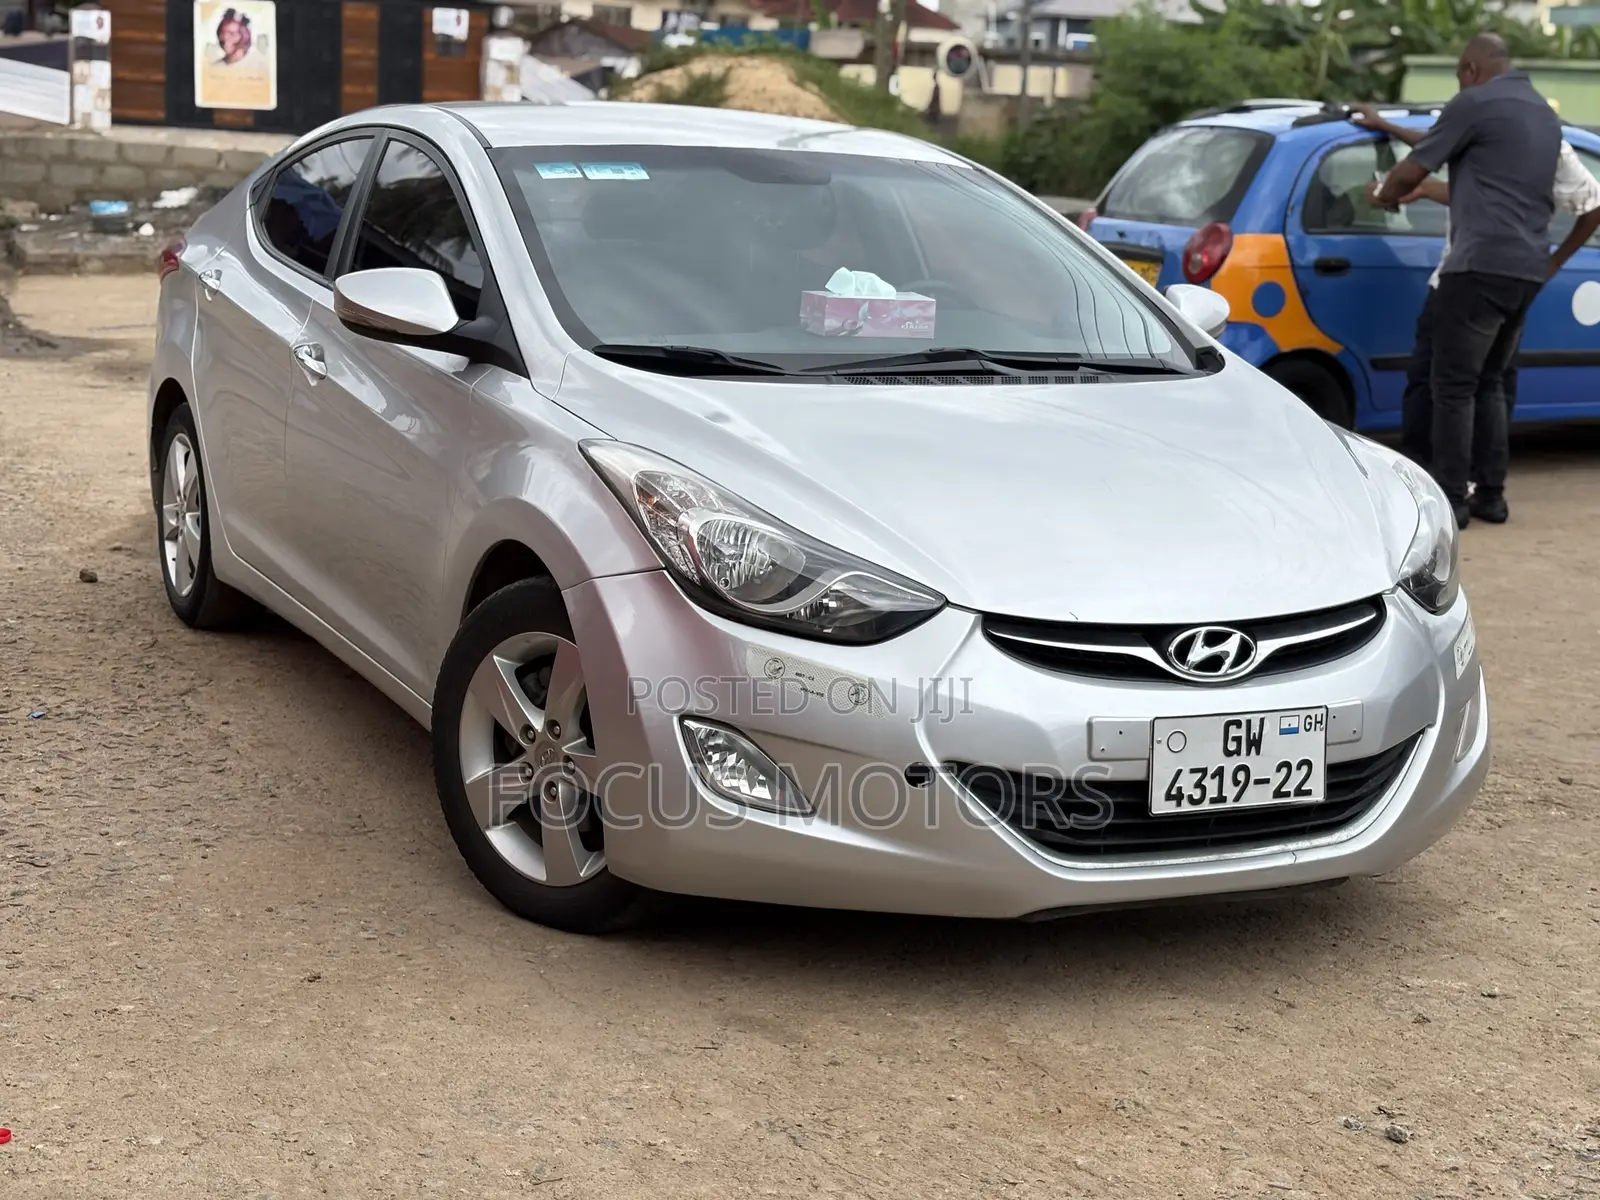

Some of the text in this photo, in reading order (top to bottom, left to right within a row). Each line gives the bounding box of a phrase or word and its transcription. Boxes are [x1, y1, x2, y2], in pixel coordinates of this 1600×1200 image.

[1222, 716, 1265, 758] GW
[1303, 713, 1324, 733] GH
[1164, 758, 1313, 808] 4319-22
